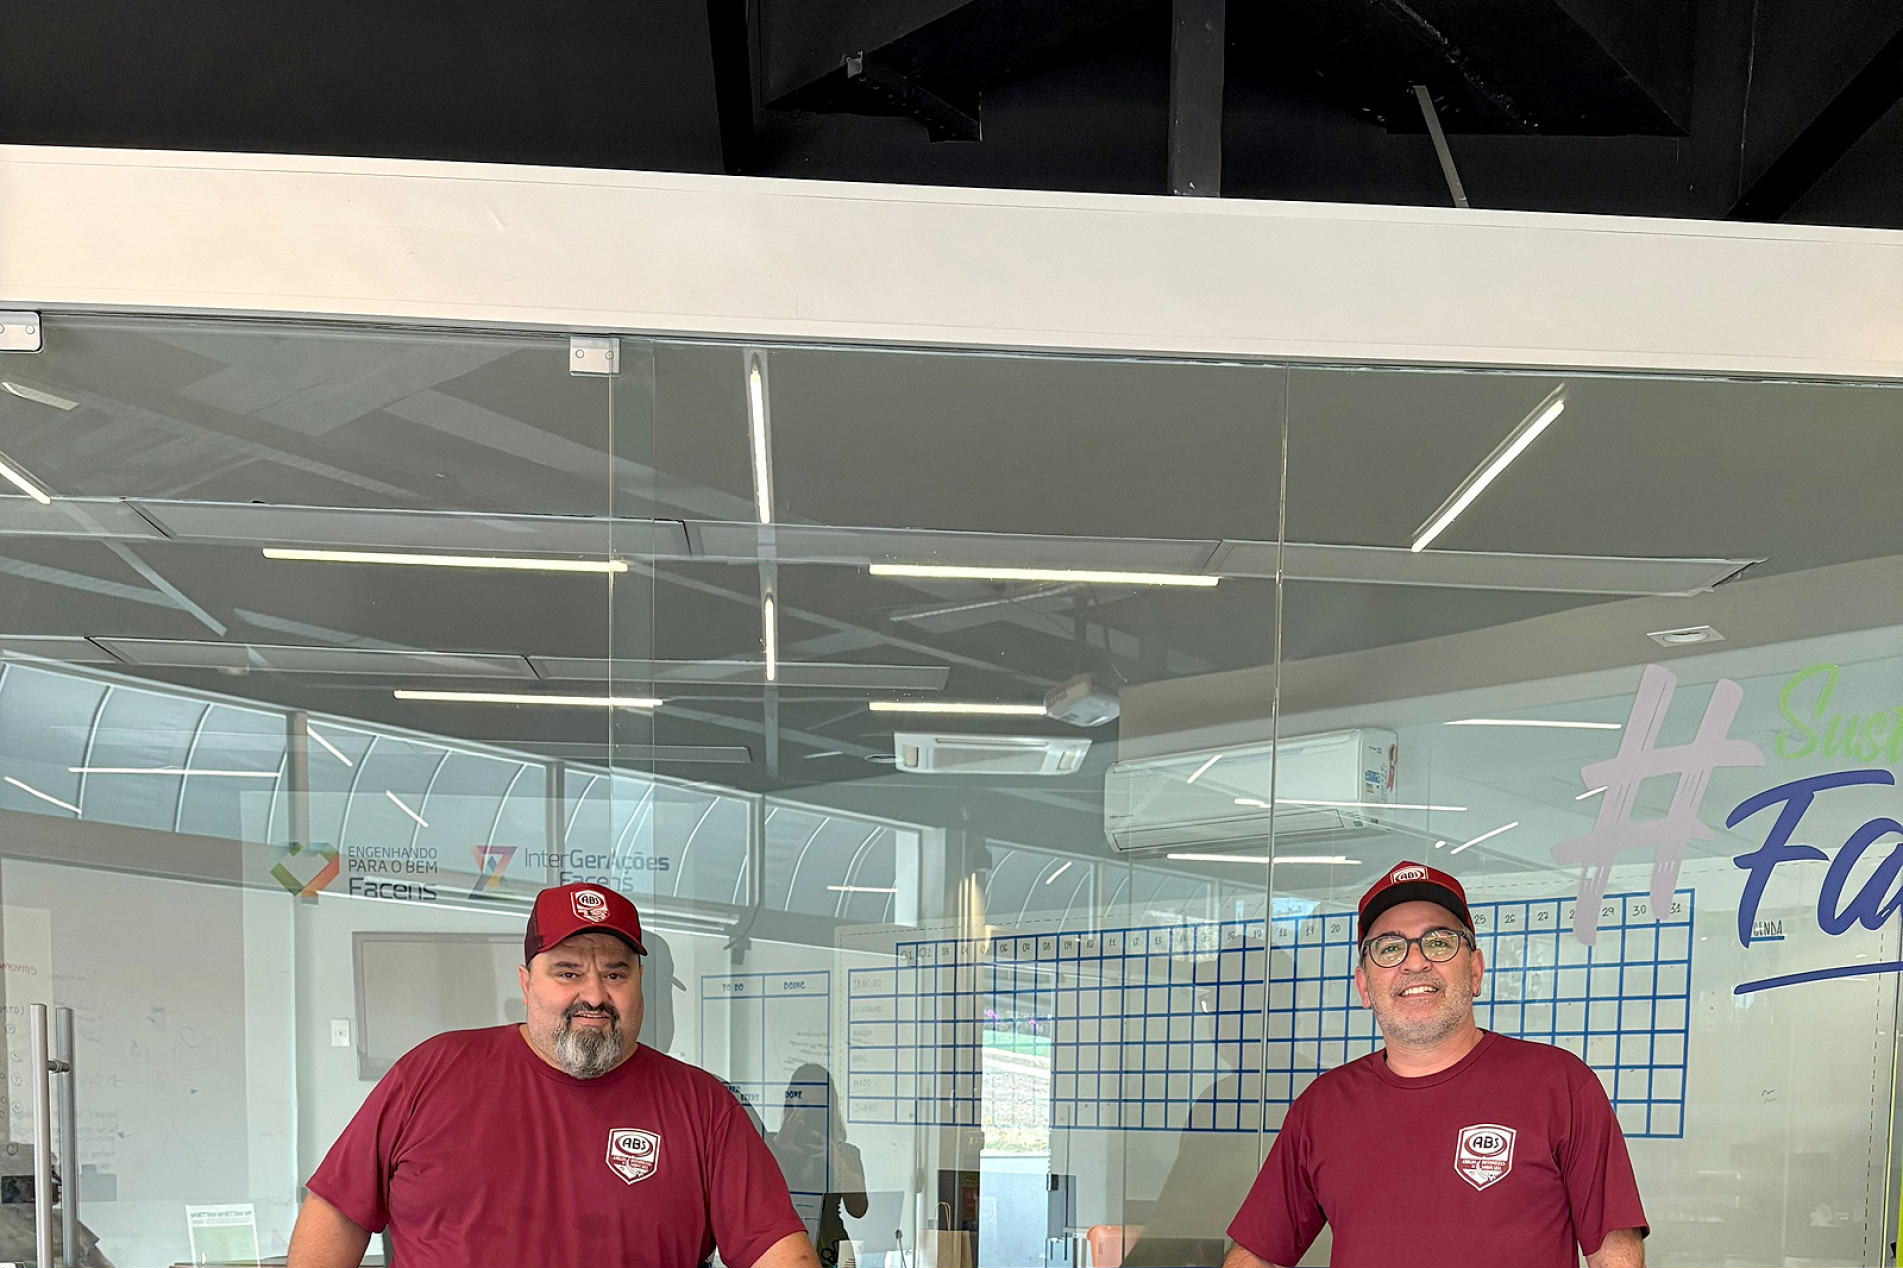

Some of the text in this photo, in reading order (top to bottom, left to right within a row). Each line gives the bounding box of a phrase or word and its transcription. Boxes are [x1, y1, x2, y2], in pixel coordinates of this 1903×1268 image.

[348, 846, 438, 859] ENGENHANDO
[348, 860, 438, 874] PARA O BEM
[349, 877, 437, 901] Facens
[1330, 923, 1341, 934] 20
[1474, 914, 1486, 925] 25
[1504, 914, 1516, 924] 26
[1569, 910, 1576, 920] 2
[1601, 907, 1615, 917] 29
[1632, 905, 1647, 916] 30
[1669, 903, 1682, 914] 31
[1752, 920, 1783, 937] GENDA
